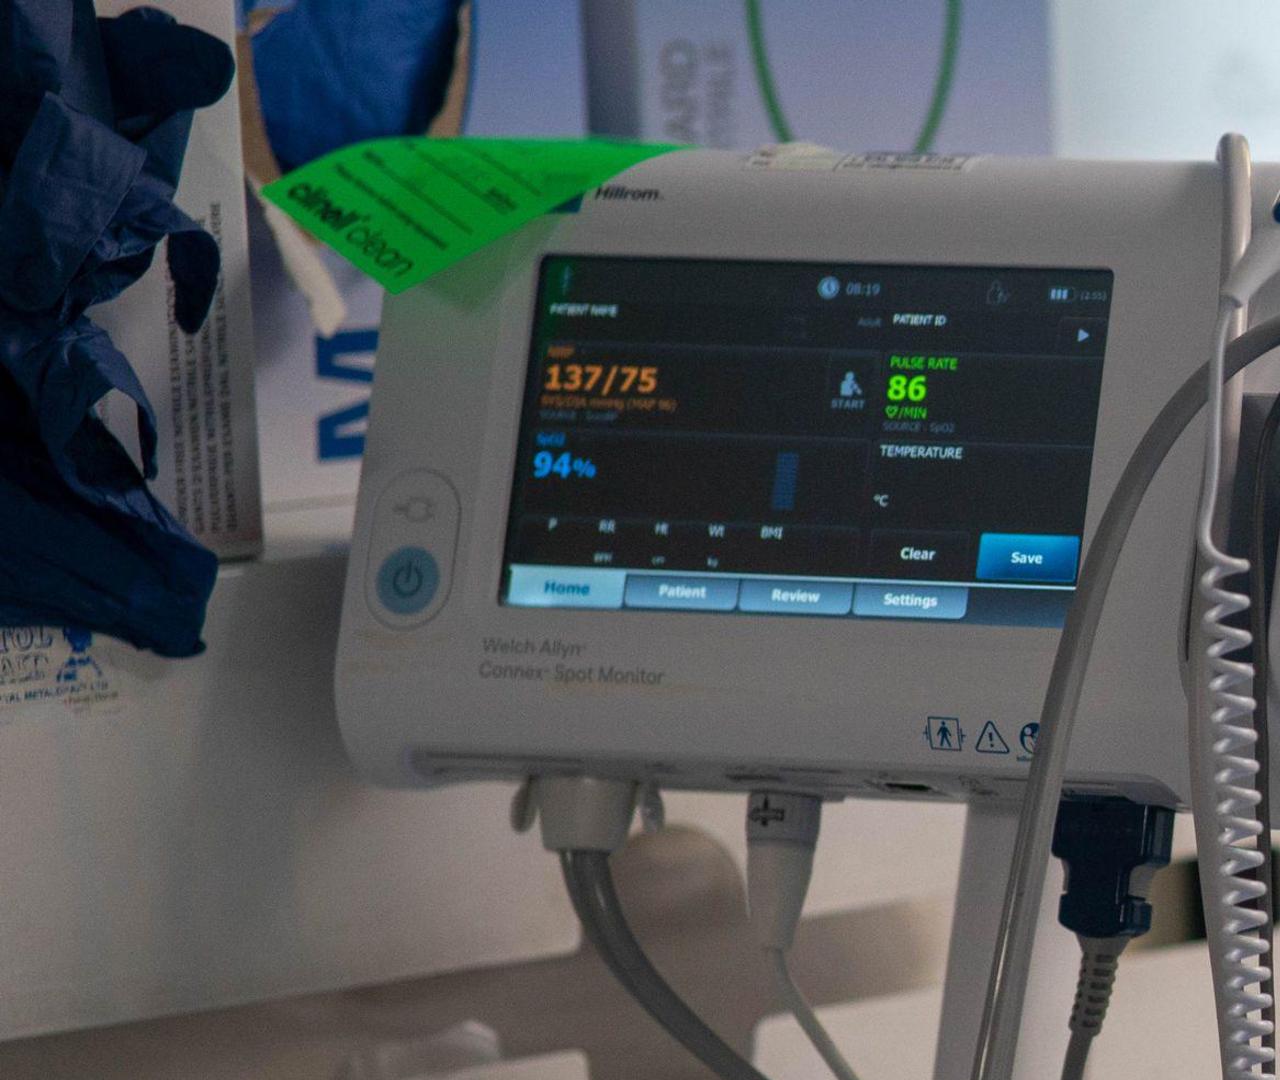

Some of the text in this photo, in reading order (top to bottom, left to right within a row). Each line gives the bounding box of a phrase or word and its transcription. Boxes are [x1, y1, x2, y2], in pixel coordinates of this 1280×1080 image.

[346, 225, 414, 278] clean
[893, 313, 947, 326] PATIENT ID
[890, 355, 958, 371] PULSE RATE
[544, 363, 658, 396] 137/75
[887, 374, 926, 401] 86
[831, 399, 865, 409] START
[880, 444, 963, 460] TEMPERATURE
[533, 450, 597, 478] 94%
[760, 526, 784, 541] BMI
[900, 547, 936, 561] Clear
[1011, 551, 1044, 565] Save
[544, 581, 590, 596] Home
[659, 585, 706, 599] Patient
[772, 588, 820, 603] Review
[883, 592, 938, 609] Settings
[482, 638, 581, 659] Welch Allyn
[555, 664, 594, 684] Spot
[600, 665, 666, 685] Monitor
